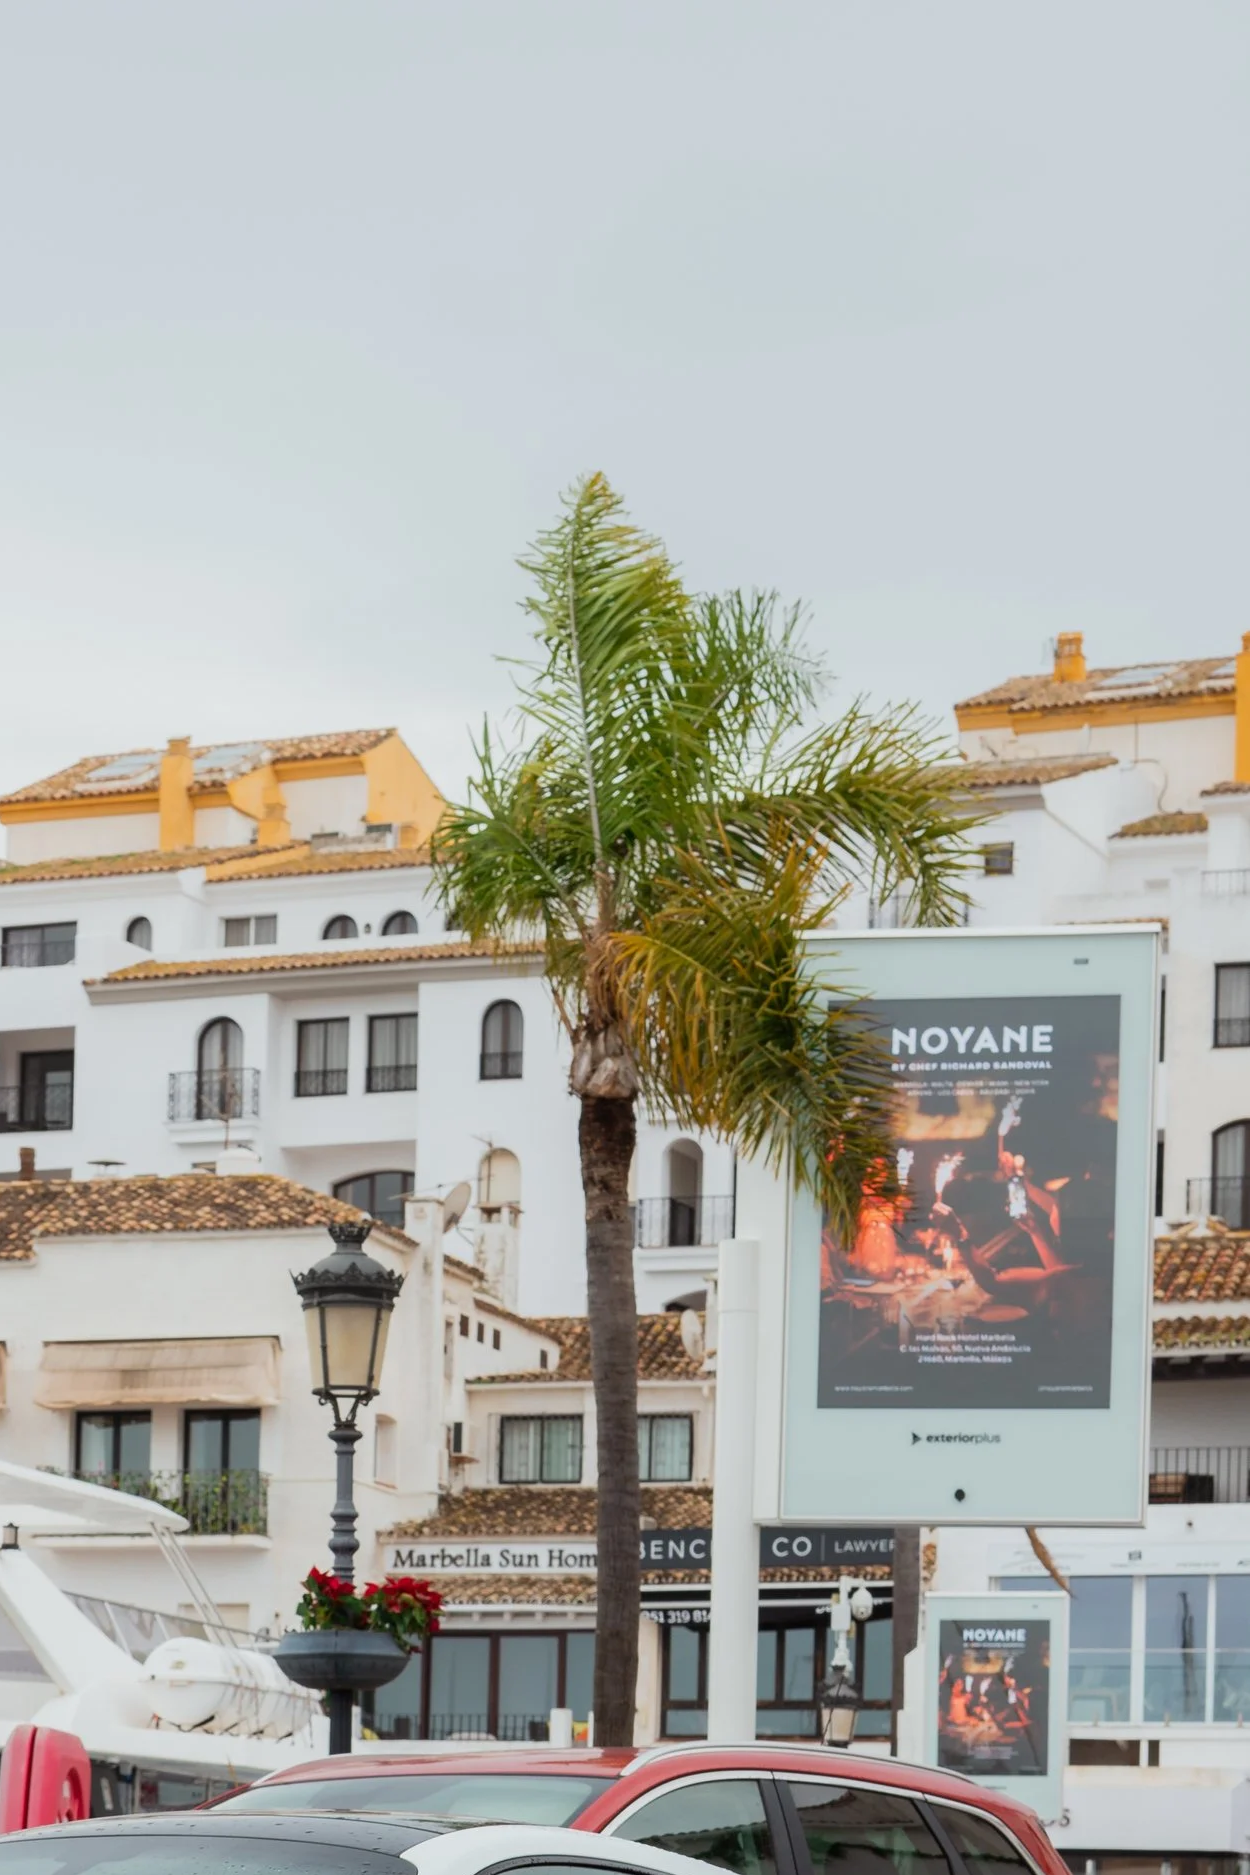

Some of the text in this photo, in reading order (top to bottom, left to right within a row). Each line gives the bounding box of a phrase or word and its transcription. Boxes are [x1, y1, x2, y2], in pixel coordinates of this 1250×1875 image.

[891, 1024, 1054, 1055] NOYANE
[891, 1060, 1052, 1072] BY CHEF RICHARD SANDOVAL
[926, 1431, 1001, 1445] exteriorplus
[772, 1536, 812, 1557] CO
[392, 1548, 491, 1568] Marbella
[499, 1549, 539, 1568] Sun
[667, 1610, 691, 1624] 319
[962, 1628, 1027, 1642] NOYANE
